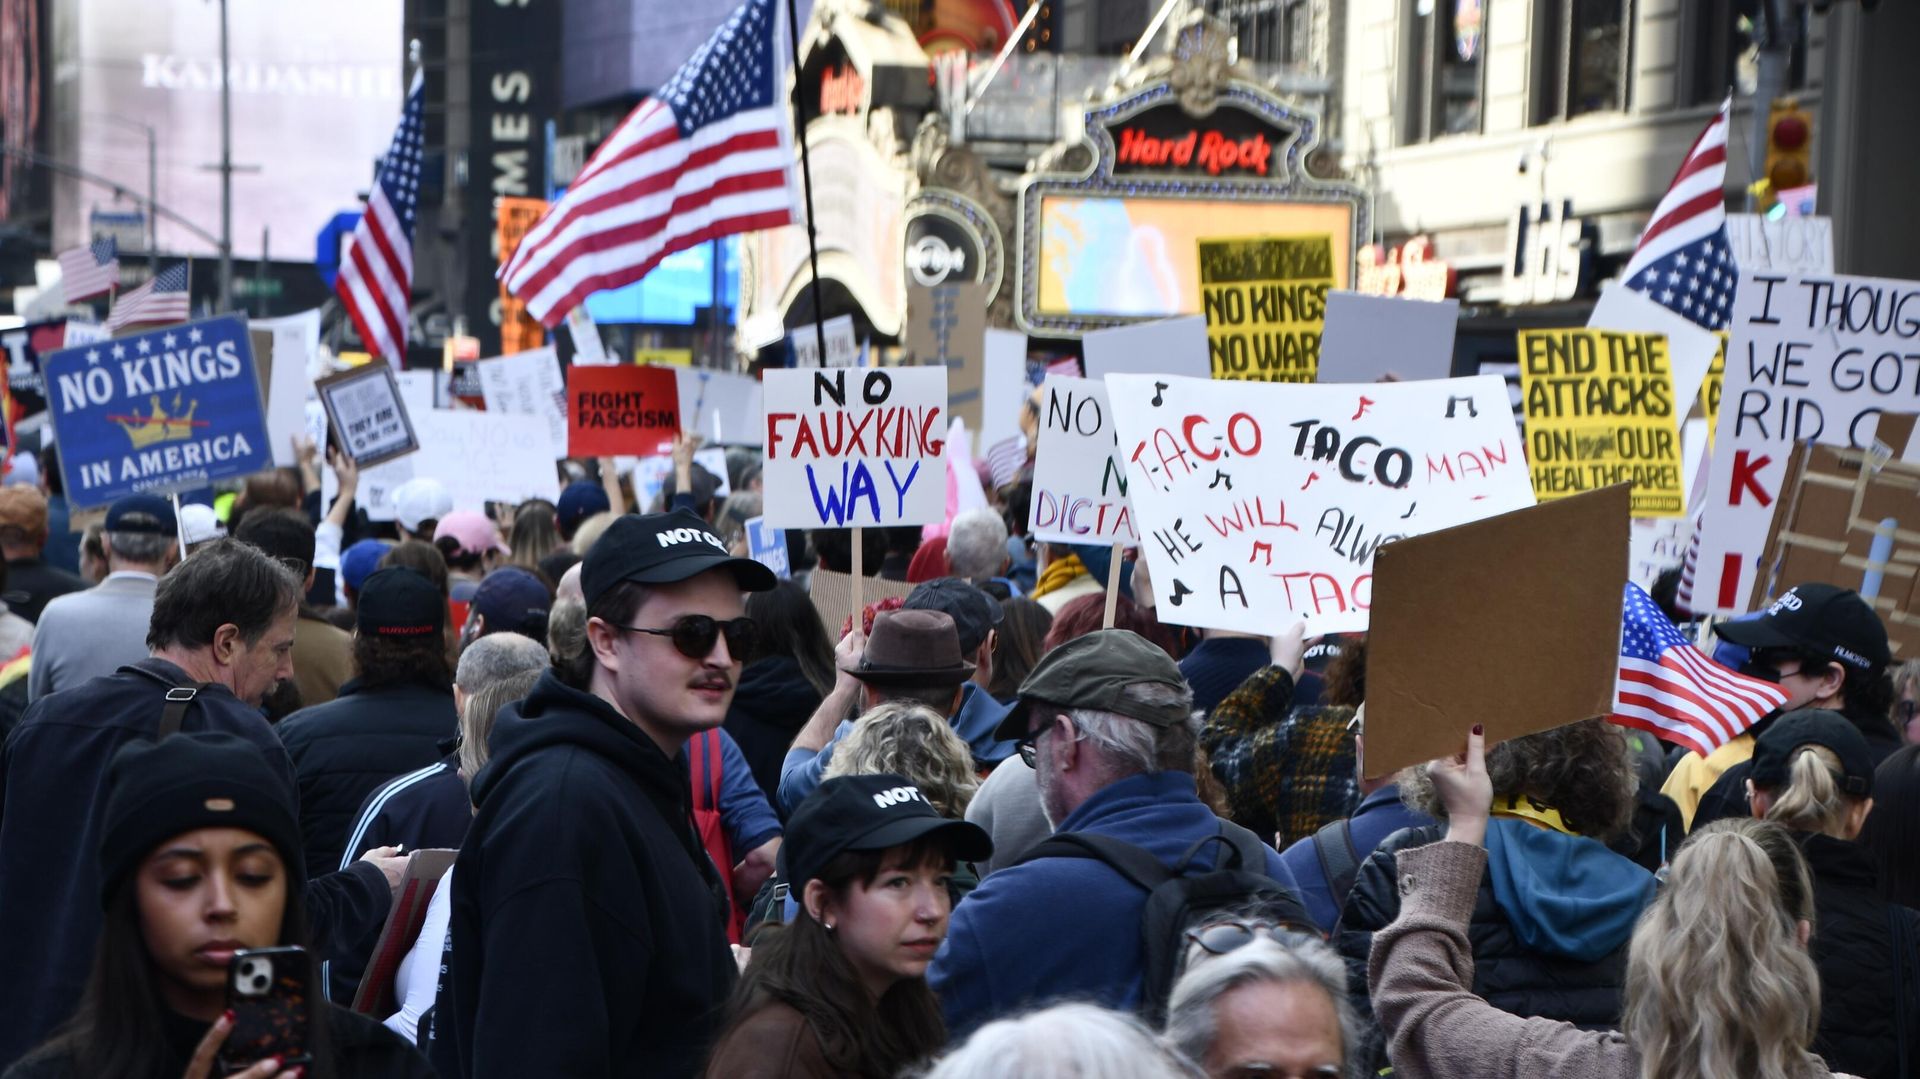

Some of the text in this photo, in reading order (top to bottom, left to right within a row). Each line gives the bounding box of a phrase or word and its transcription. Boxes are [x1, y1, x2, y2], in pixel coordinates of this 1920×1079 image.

[1118, 127, 1271, 176] Hard Rock
[1204, 282, 1332, 327] NO KINGS
[1748, 275, 1788, 325] I
[1208, 332, 1249, 373] NO
[1526, 332, 1669, 376] END THE
[1747, 340, 1814, 388] WE
[1831, 347, 1920, 397] GOT
[57, 340, 242, 414] NO KINGS
[578, 391, 644, 409] FIGHT
[814, 370, 892, 407] NO
[1528, 376, 1672, 418] ATTACKS
[578, 410, 675, 429] FASCISM
[767, 405, 945, 459] FAUXKING
[1048, 387, 1102, 436] NO
[1735, 388, 1825, 442] RID
[80, 432, 252, 489] IN AMERICA
[1426, 438, 1508, 484] MAN
[1533, 426, 1677, 463] ON OUR
[805, 459, 919, 527] WAY
[1535, 462, 1680, 493] HEALTHCARE!
[656, 528, 702, 548] NOT
[1035, 489, 1141, 541] DICTA
[1152, 518, 1204, 566] HE
[1205, 496, 1299, 538] WILL
[1219, 564, 1250, 611] A
[872, 786, 920, 809] NOT
